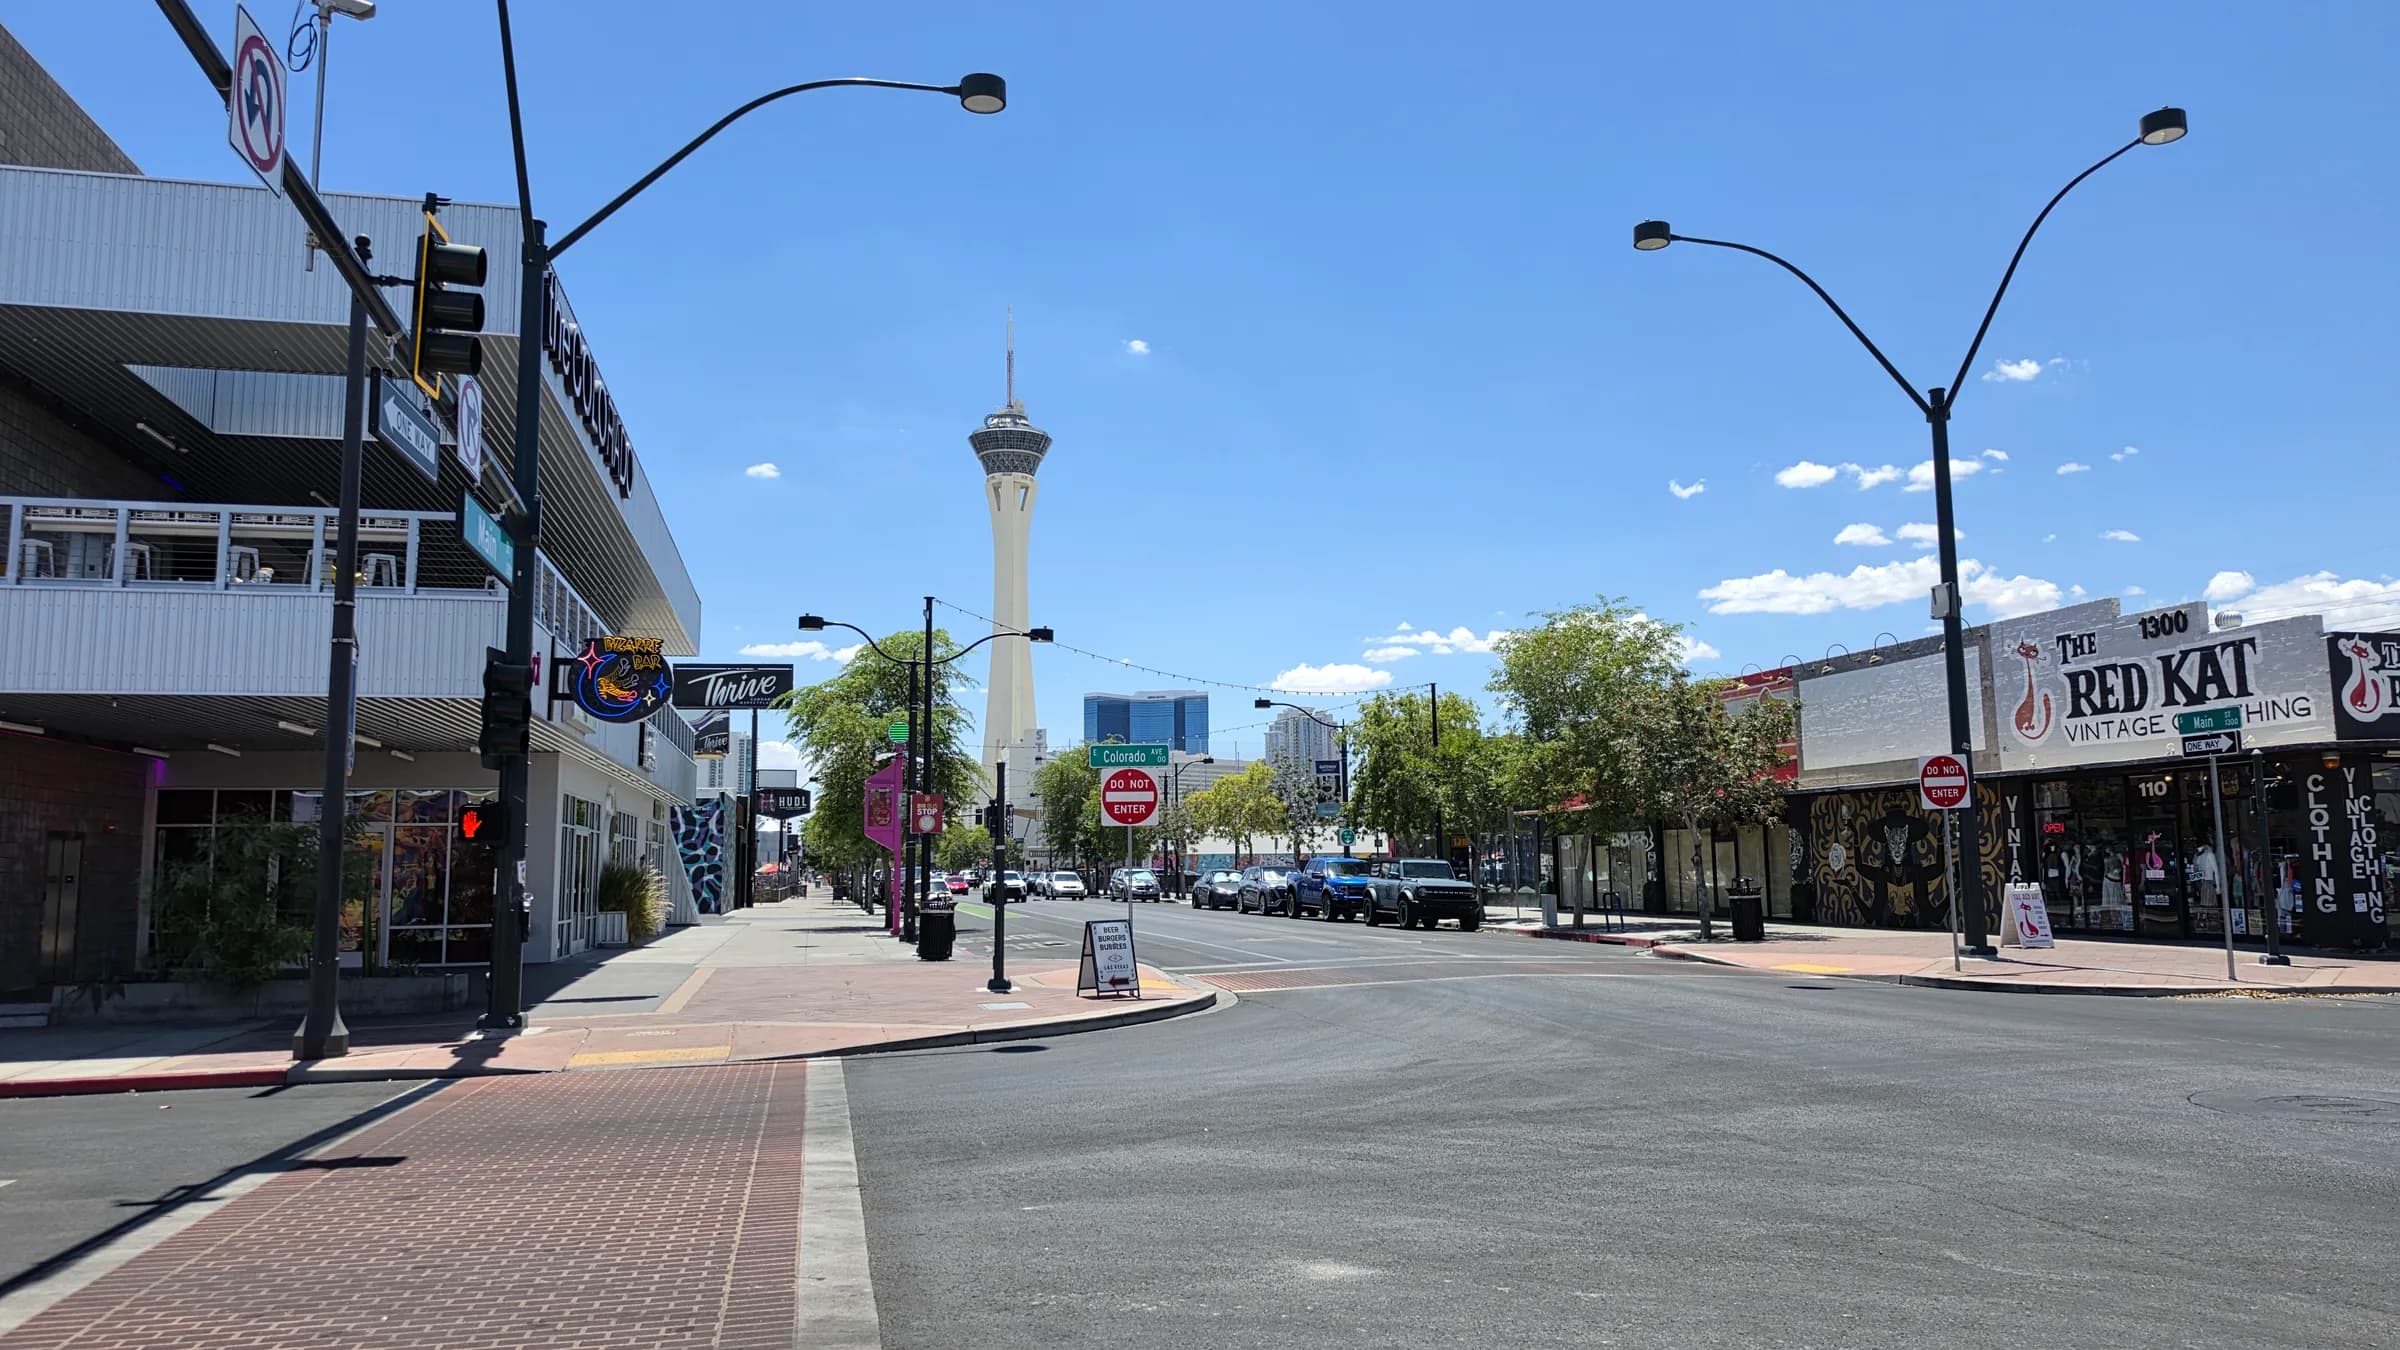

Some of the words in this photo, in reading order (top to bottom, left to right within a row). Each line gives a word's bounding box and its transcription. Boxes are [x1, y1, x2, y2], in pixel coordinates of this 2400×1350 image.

[396, 410, 412, 441] ONE
[414, 425, 432, 457] WAY
[477, 513, 498, 557] Main
[2138, 610, 2188, 640] 1300
[603, 636, 664, 654] BIZARRE
[2056, 632, 2097, 665] THE
[632, 655, 661, 671] BAR
[2063, 662, 2149, 719] RED
[2157, 637, 2257, 708] KAT
[687, 669, 777, 706] Thrive
[2064, 714, 2166, 742] VINTAGE
[2193, 715, 2214, 729] Main
[2224, 717, 2239, 726] 1300
[698, 732, 729, 751] Thrive
[2187, 741, 2203, 751] ONE
[2205, 739, 2220, 749] WAY
[1093, 749, 1097, 757] E
[1103, 749, 1146, 763] Colorado
[1926, 767, 1939, 775] DO
[1943, 765, 1960, 775] NOT
[1110, 779, 1125, 789] DO
[1129, 779, 1150, 789] NOT
[2138, 781, 2167, 797] 110
[1931, 788, 1959, 798] ENTER
[779, 796, 807, 807] HUDL
[1114, 804, 1146, 814] ENTER
[916, 808, 938, 816] STOP
[2043, 822, 2065, 833] OPEN
[2343, 767, 2367, 879] VINTAGE
[2005, 795, 2022, 884] VINTA
[2306, 774, 2337, 913] CLOTHING
[2359, 795, 2385, 924] CLOTHING
[1098, 934, 1127, 942] BURGERS
[1103, 926, 1119, 934] BEER
